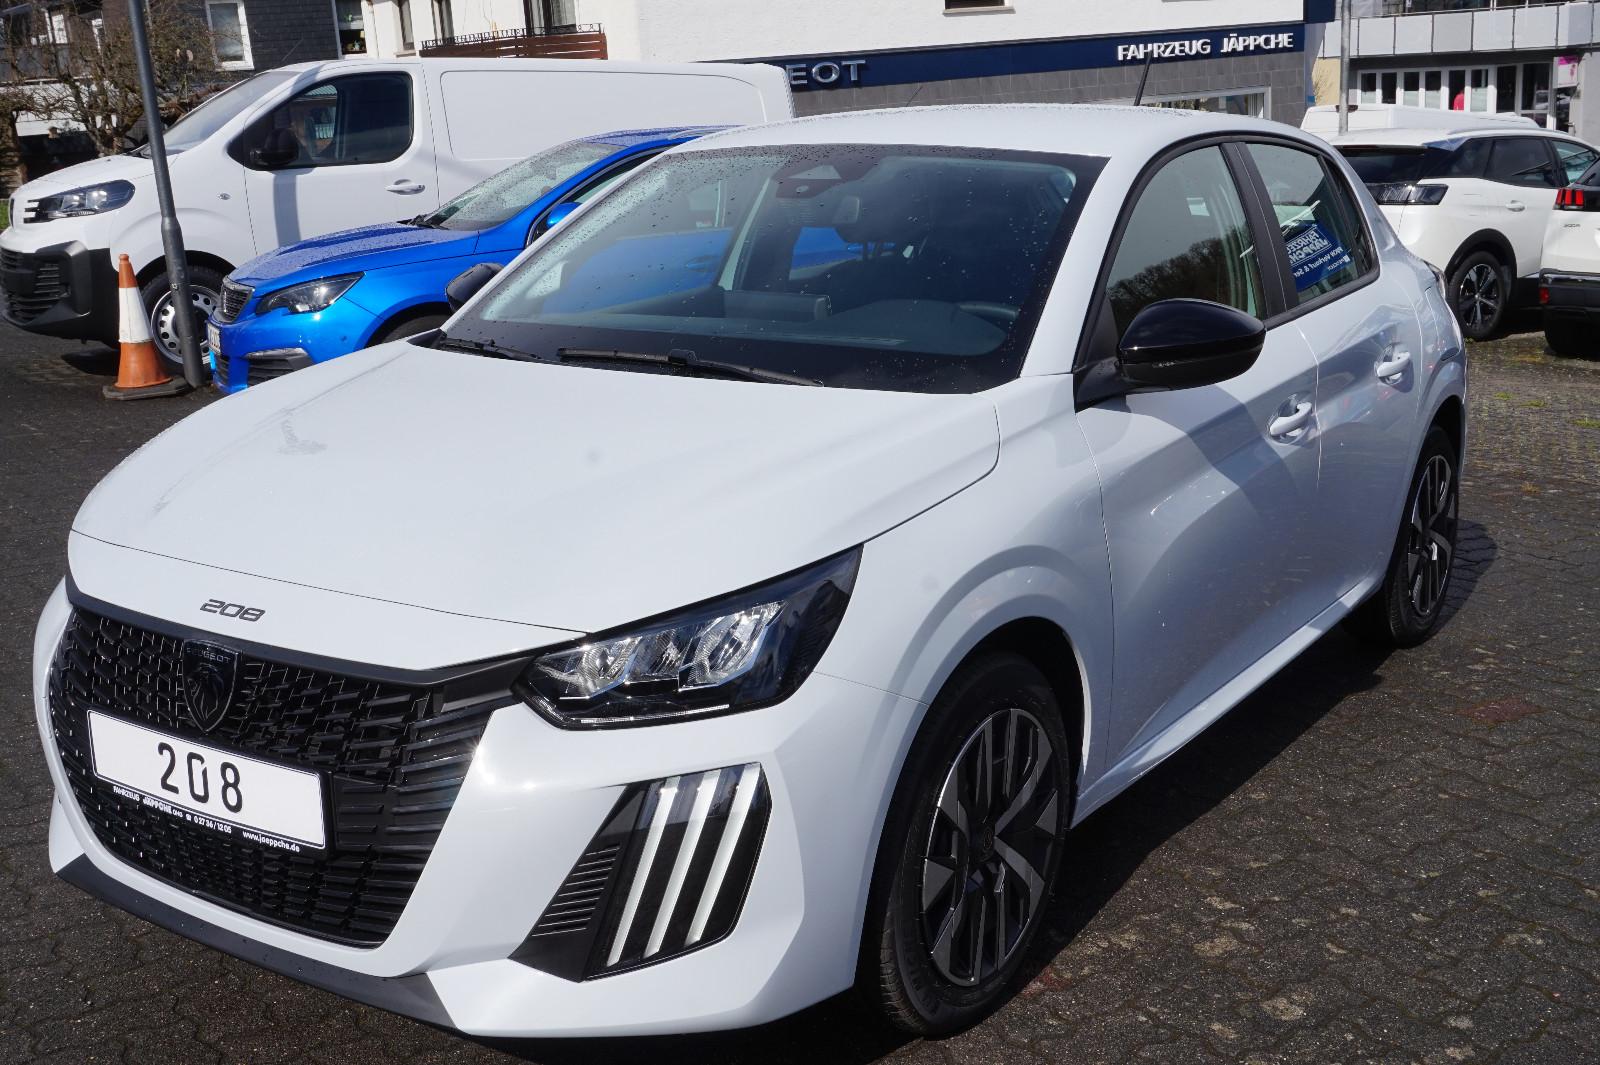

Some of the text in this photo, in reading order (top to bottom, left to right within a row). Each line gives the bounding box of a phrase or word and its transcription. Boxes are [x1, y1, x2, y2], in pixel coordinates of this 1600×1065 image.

[1117, 33, 1294, 61] FAHRZEUG JÄPPCHE
[200, 598, 266, 622] 208
[158, 741, 243, 813] 208
